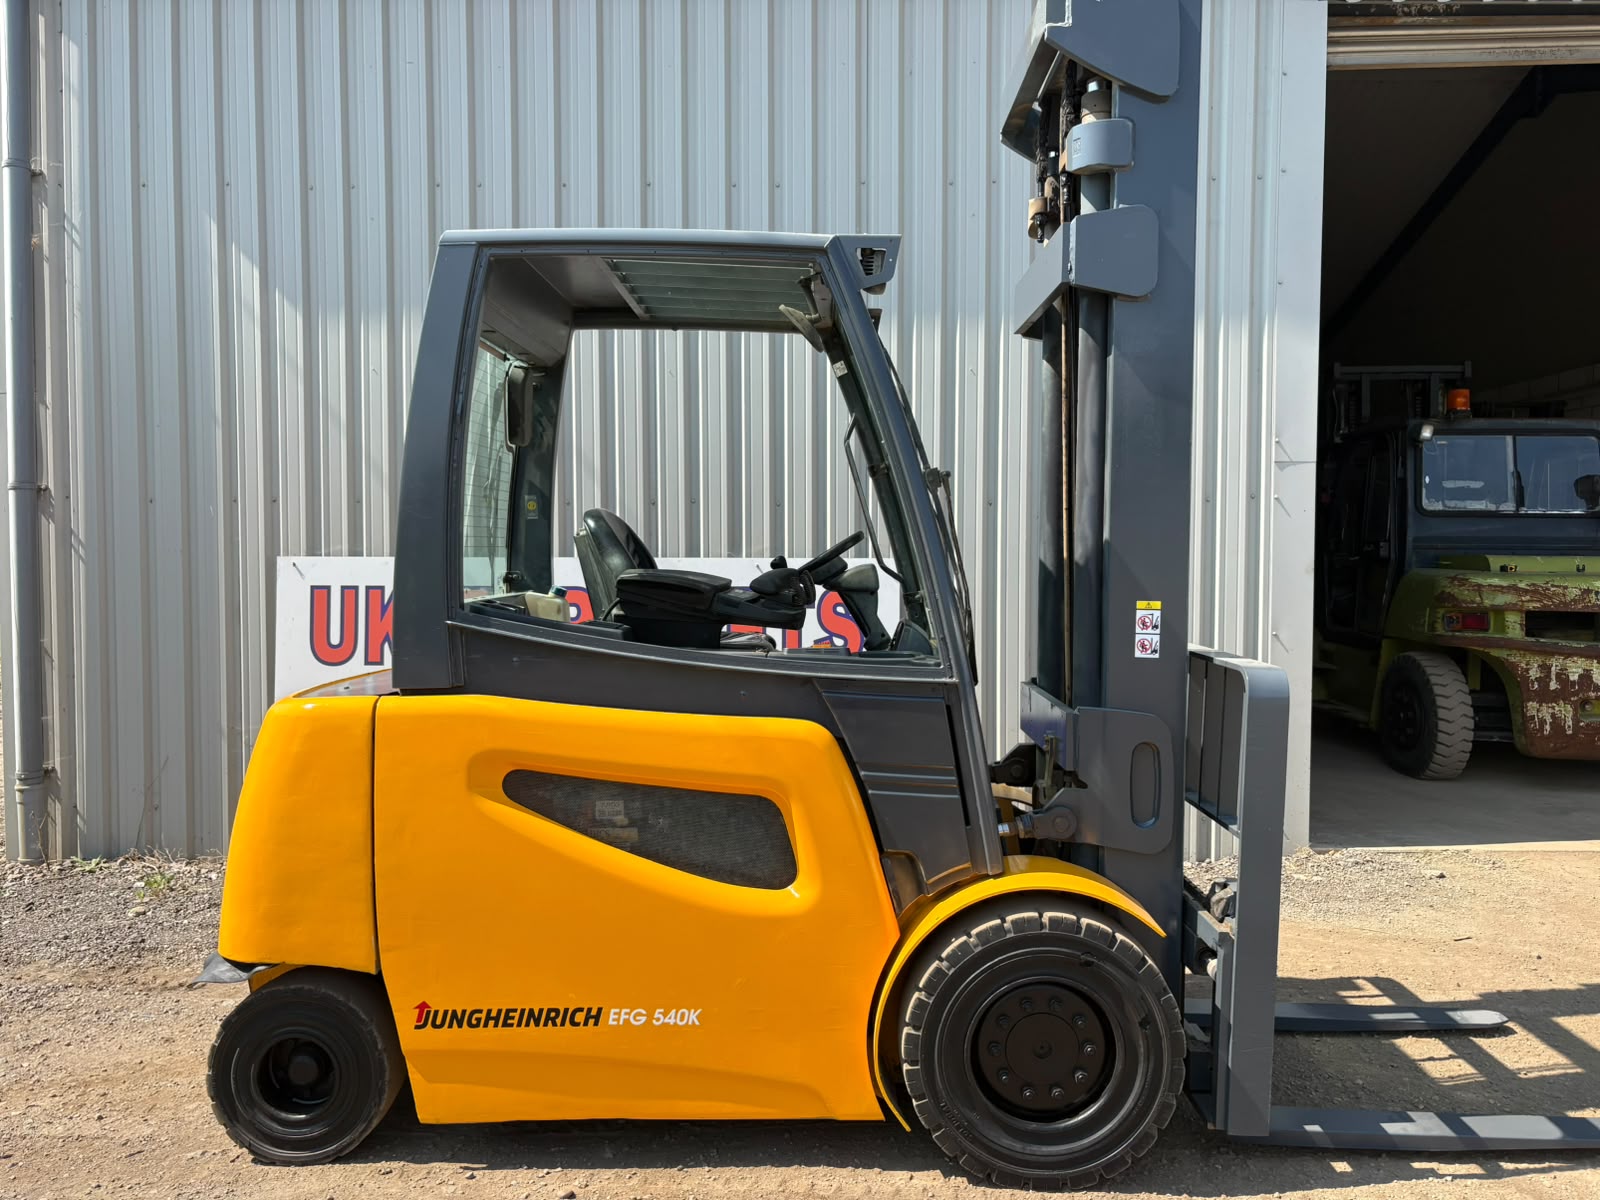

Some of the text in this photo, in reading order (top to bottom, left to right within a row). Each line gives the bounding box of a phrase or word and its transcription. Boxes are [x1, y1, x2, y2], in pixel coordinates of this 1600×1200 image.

[413, 1006, 703, 1030] JUNGHEINRICH EFG 540K
